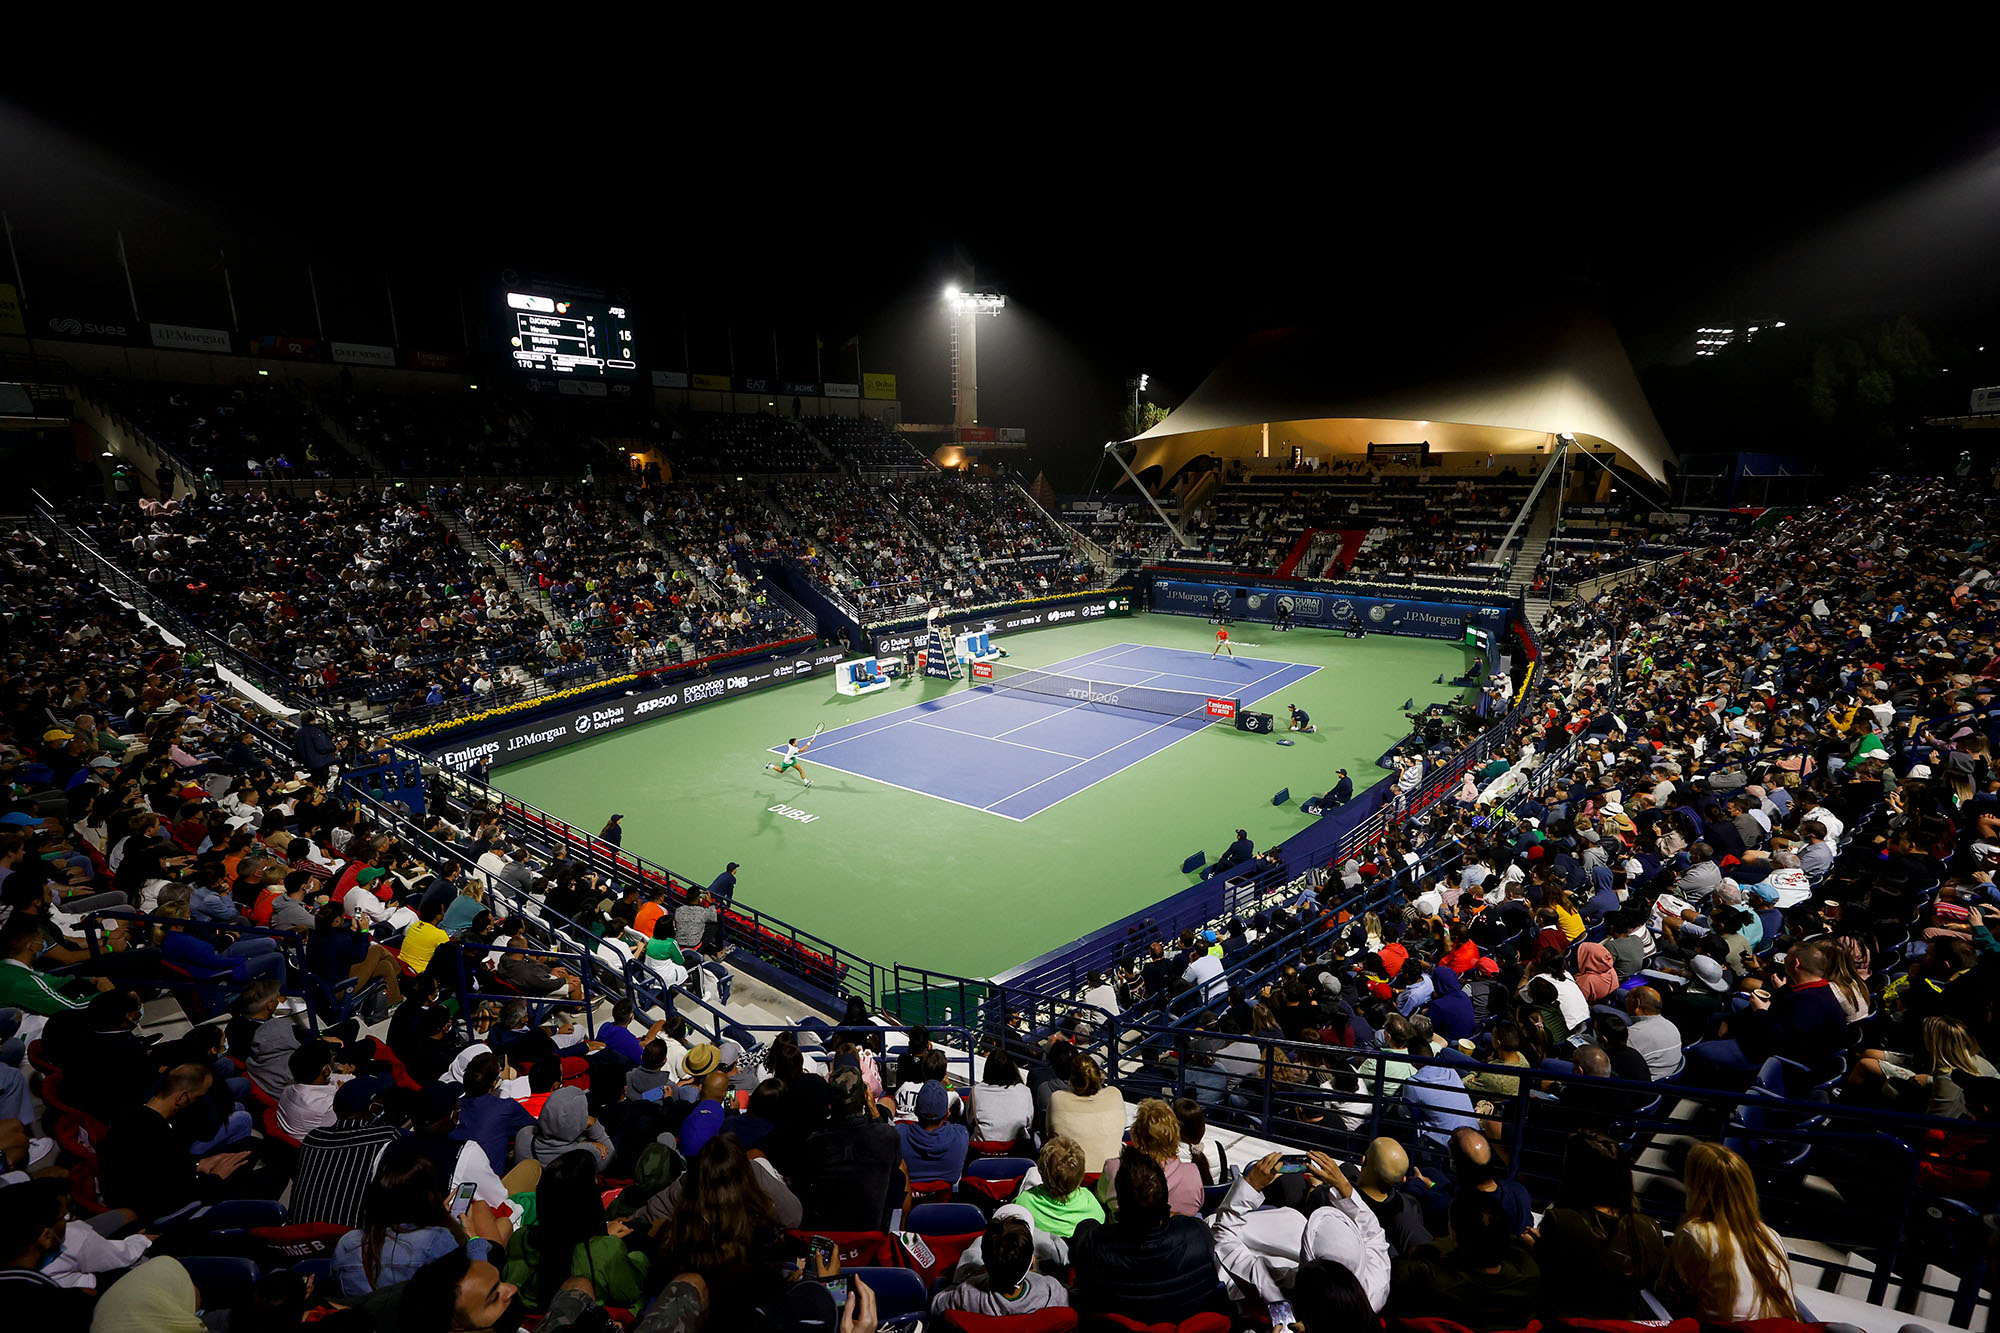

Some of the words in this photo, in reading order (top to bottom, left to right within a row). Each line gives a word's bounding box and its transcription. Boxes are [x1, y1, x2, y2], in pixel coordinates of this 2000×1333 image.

[83, 323, 128, 337] suez
[157, 325, 226, 346] J.P.Morgan
[588, 325, 596, 337] 2
[619, 330, 632, 341] 15
[590, 344, 596, 355] 1
[623, 348, 630, 359] 0
[517, 360, 533, 369] 170
[1166, 590, 1208, 603] J.P.Morgan
[1059, 610, 1076, 618] suez
[1403, 612, 1461, 626] J.P.Morgan
[1006, 619, 1021, 629] GULF
[891, 638, 910, 646] Dubai
[815, 654, 843, 666] J.P.Morgan
[684, 684, 706, 696] EXPO
[705, 679, 725, 691] 2020
[684, 690, 708, 704] DUBAI
[709, 687, 725, 697] UAE
[1066, 688, 1089, 698] ATP
[1089, 691, 1119, 706] TOUR
[1207, 700, 1234, 711] Emirates
[592, 707, 625, 722] Dubai
[594, 721, 610, 730] Duty
[610, 716, 625, 725] Free
[507, 726, 567, 752] J.P.Morgan
[444, 741, 500, 766] Emirates
[767, 803, 821, 825] DUBAI
[1308, 805, 1323, 815] EA7
[310, 1240, 326, 1251] B
